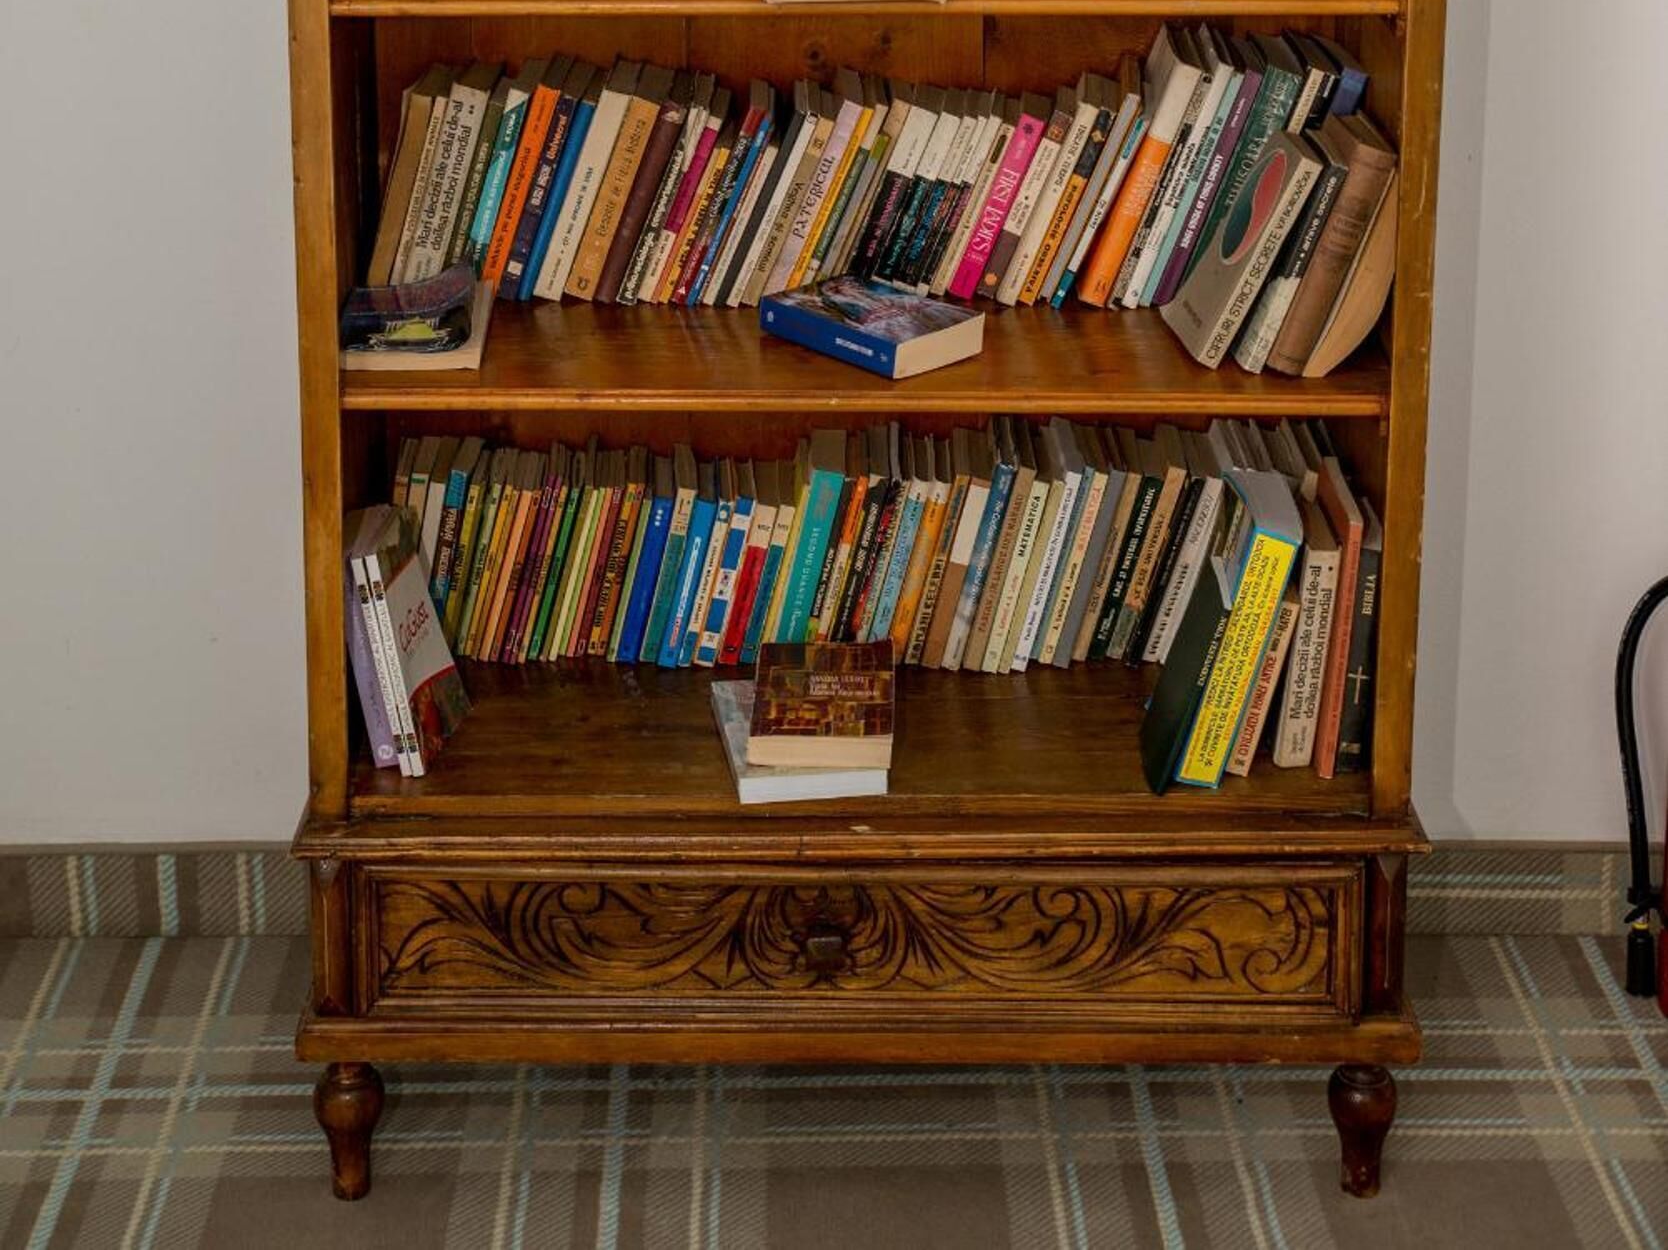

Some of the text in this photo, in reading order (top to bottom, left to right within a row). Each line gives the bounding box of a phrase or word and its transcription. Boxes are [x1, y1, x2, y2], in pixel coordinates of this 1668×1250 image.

[414, 98, 465, 249] Mari decizii ale celui de-al
[428, 213, 450, 251] doilea
[447, 123, 474, 176] mondial
[788, 153, 839, 239] PATERICUL
[968, 165, 1021, 254] FIRST LADIES
[1313, 173, 1340, 217] secrete
[1203, 315, 1236, 361] CIFRURI
[1227, 278, 1257, 318] STRICT
[1247, 229, 1283, 281] SECRETE
[1016, 494, 1041, 558] MATEMATICA
[1360, 573, 1380, 616] BIBLIA
[1259, 653, 1278, 684] ANTICE
[1275, 606, 1294, 633] MATEI
[1287, 563, 1323, 721] Mari decizii ale celui de-al
[1299, 678, 1320, 719] doilea
[1312, 586, 1335, 640] mondial
